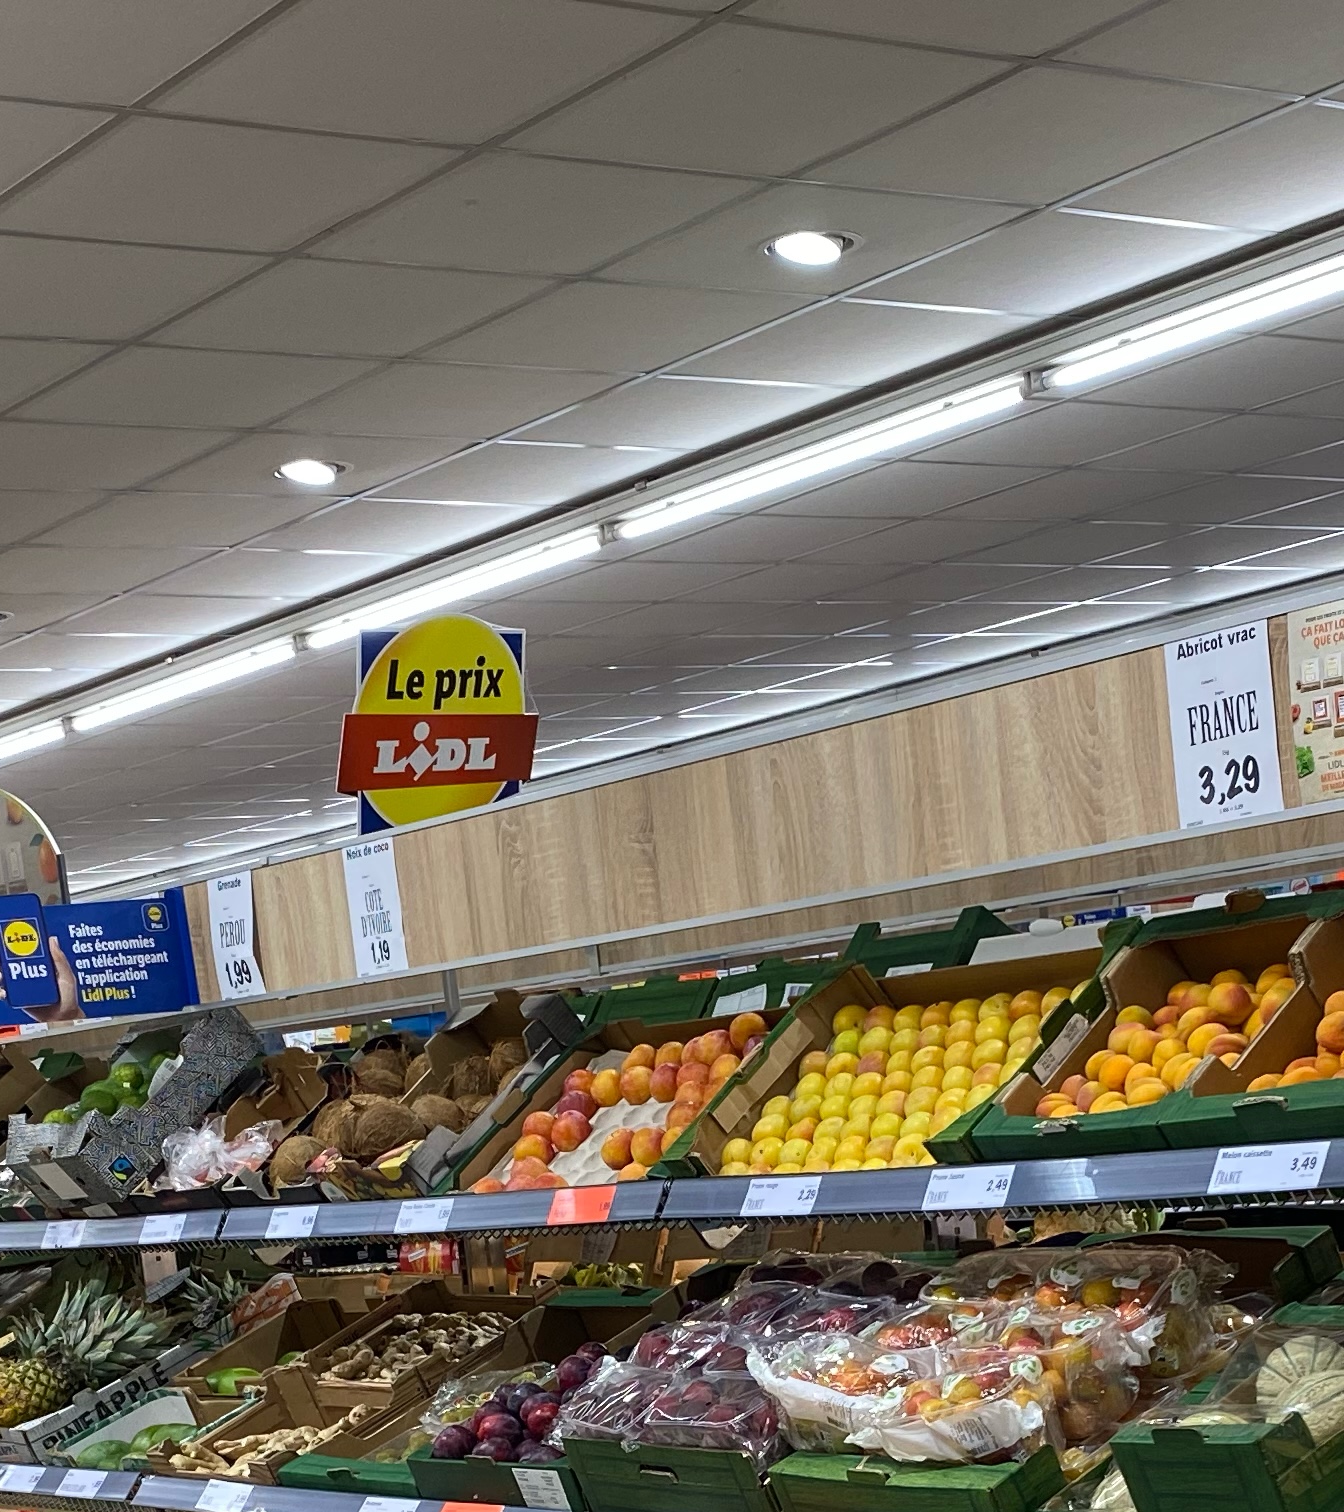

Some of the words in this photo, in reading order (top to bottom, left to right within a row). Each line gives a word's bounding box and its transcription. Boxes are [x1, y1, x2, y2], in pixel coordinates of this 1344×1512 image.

[1302, 627, 1312, 639] ÇA
[1314, 621, 1333, 635] FAIT
[1177, 633, 1223, 660] Abricot
[1228, 627, 1256, 645] vrac
[1314, 635, 1331, 649] QUE
[1333, 632, 1344, 645] ÇA
[387, 659, 425, 700] Le
[434, 656, 504, 710] prix
[1187, 690, 1259, 746] FRANCE
[1328, 761, 1344, 770] LIDL
[1199, 755, 1260, 805] 3,29
[346, 848, 362, 860] Noix
[363, 846, 372, 856] de
[374, 843, 389, 853] coco
[68, 924, 103, 938] Faites
[220, 919, 245, 949] PEROU
[72, 940, 93, 953] des
[95, 935, 155, 951] économies
[371, 940, 390, 965] 1,19
[76, 958, 90, 969] en
[92, 950, 168, 969] téléchargeant
[8, 962, 48, 980] Plus
[78, 968, 148, 986] l'application
[225, 959, 252, 989] 1,99
[81, 988, 104, 1002] Lidl
[106, 988, 130, 1001] Plus
[1290, 1157, 1317, 1172] 3,49
[986, 1179, 1008, 1192] 2,49
